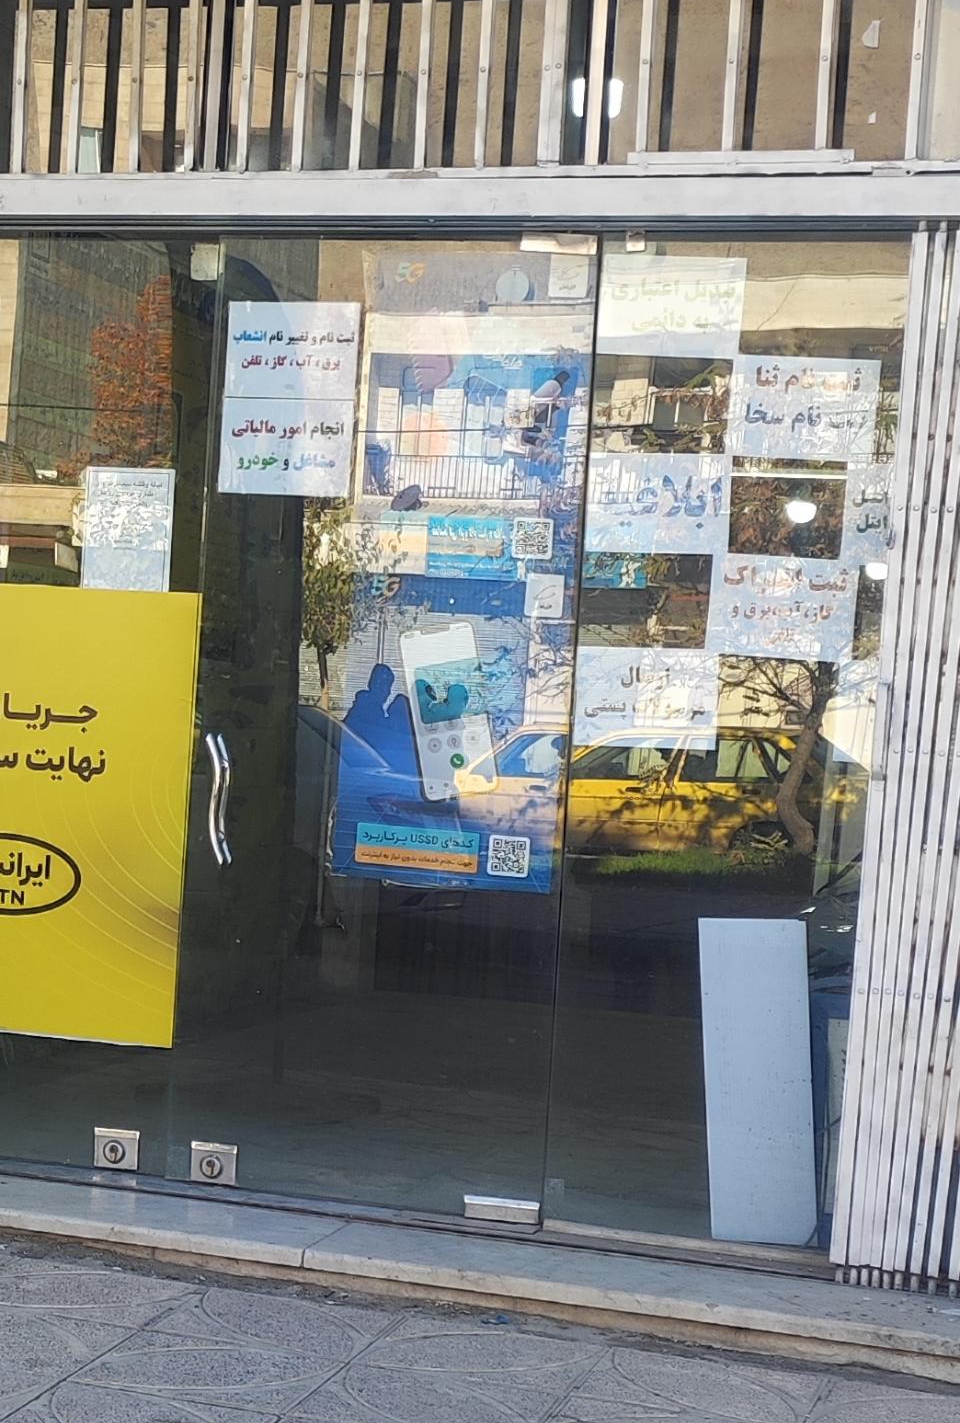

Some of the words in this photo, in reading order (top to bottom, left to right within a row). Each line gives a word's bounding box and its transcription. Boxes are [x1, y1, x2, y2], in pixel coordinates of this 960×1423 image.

[233, 329, 267, 344] انشعاب
[269, 330, 283, 345] نام
[320, 332, 334, 345] نام
[337, 330, 355, 346] ثبت
[242, 354, 262, 368] تلفن
[756, 364, 780, 387] ثنا
[785, 368, 816, 395] نام
[232, 419, 276, 437] مالیاتی
[792, 405, 822, 433] نام
[279, 421, 307, 438] امور
[311, 421, 344, 440] انجام
[236, 452, 279, 470] خودرو
[281, 458, 289, 470] و
[293, 453, 336, 471] مشاغل
[598, 475, 722, 529] ابلاغی
[809, 568, 849, 597] ثبت
[584, 698, 626, 719] پستی
[26, 746, 106, 782] نهایت
[410, 834, 438, 845] USSD
